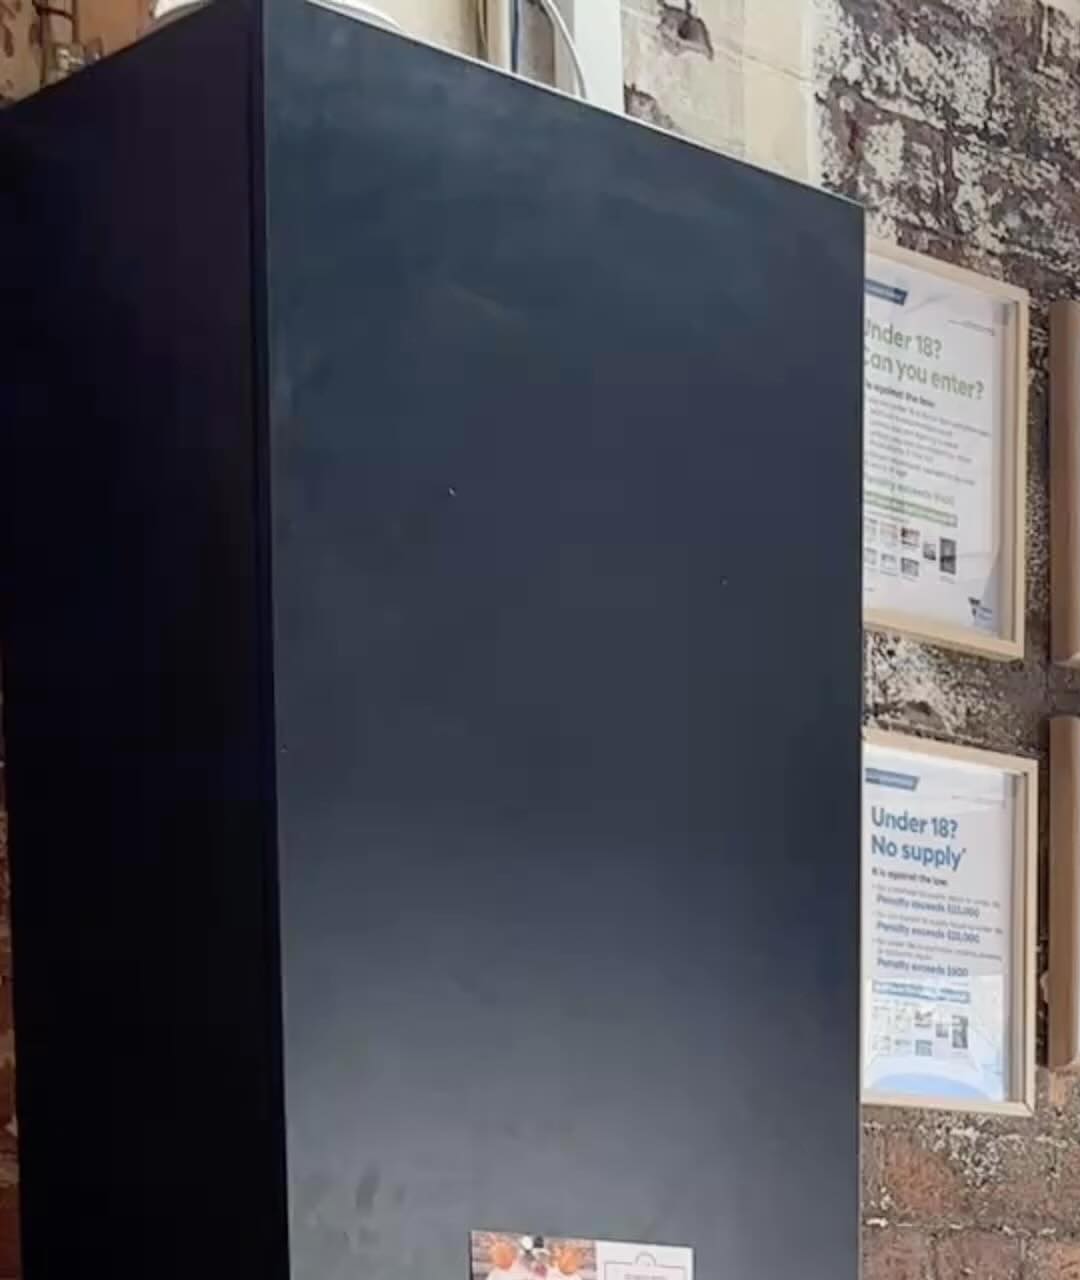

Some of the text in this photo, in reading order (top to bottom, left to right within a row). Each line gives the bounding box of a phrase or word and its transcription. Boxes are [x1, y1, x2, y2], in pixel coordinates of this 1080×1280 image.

[915, 335, 943, 359] 18?
[896, 358, 927, 384] you
[931, 371, 984, 400] enter?
[872, 805, 958, 839] Under 18?
[872, 834, 897, 857] No
